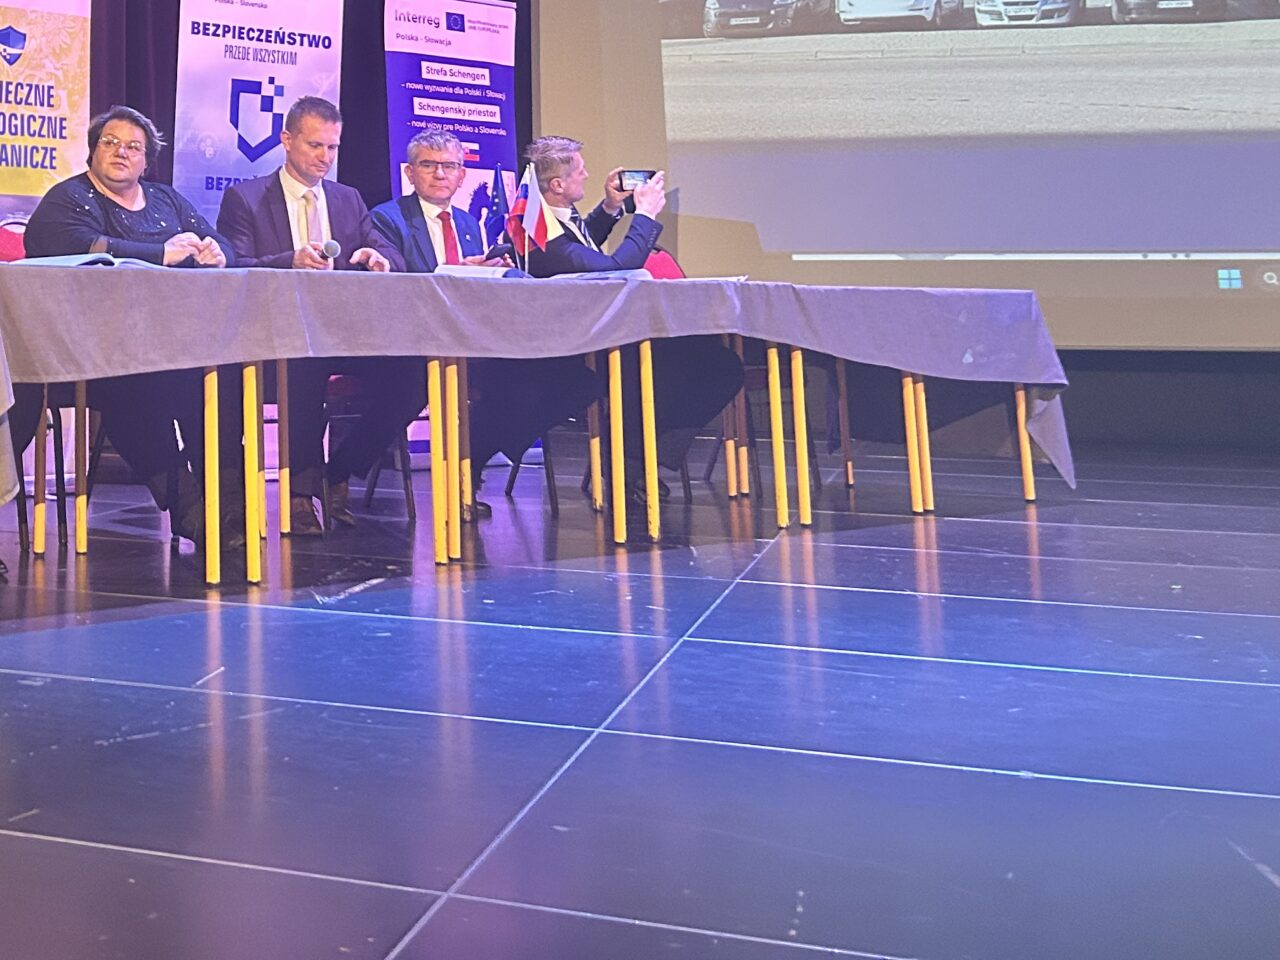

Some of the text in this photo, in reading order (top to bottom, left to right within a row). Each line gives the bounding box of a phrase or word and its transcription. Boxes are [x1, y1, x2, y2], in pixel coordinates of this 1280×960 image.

[394, 9, 440, 28] Interreg
[191, 21, 332, 49] BEZPIECZEŃSTWO
[396, 33, 419, 42] Polska
[224, 44, 297, 66] PRZEDE WSZYSTKIM
[425, 66, 486, 81] Strefa Schengen
[468, 108, 497, 118] priestor
